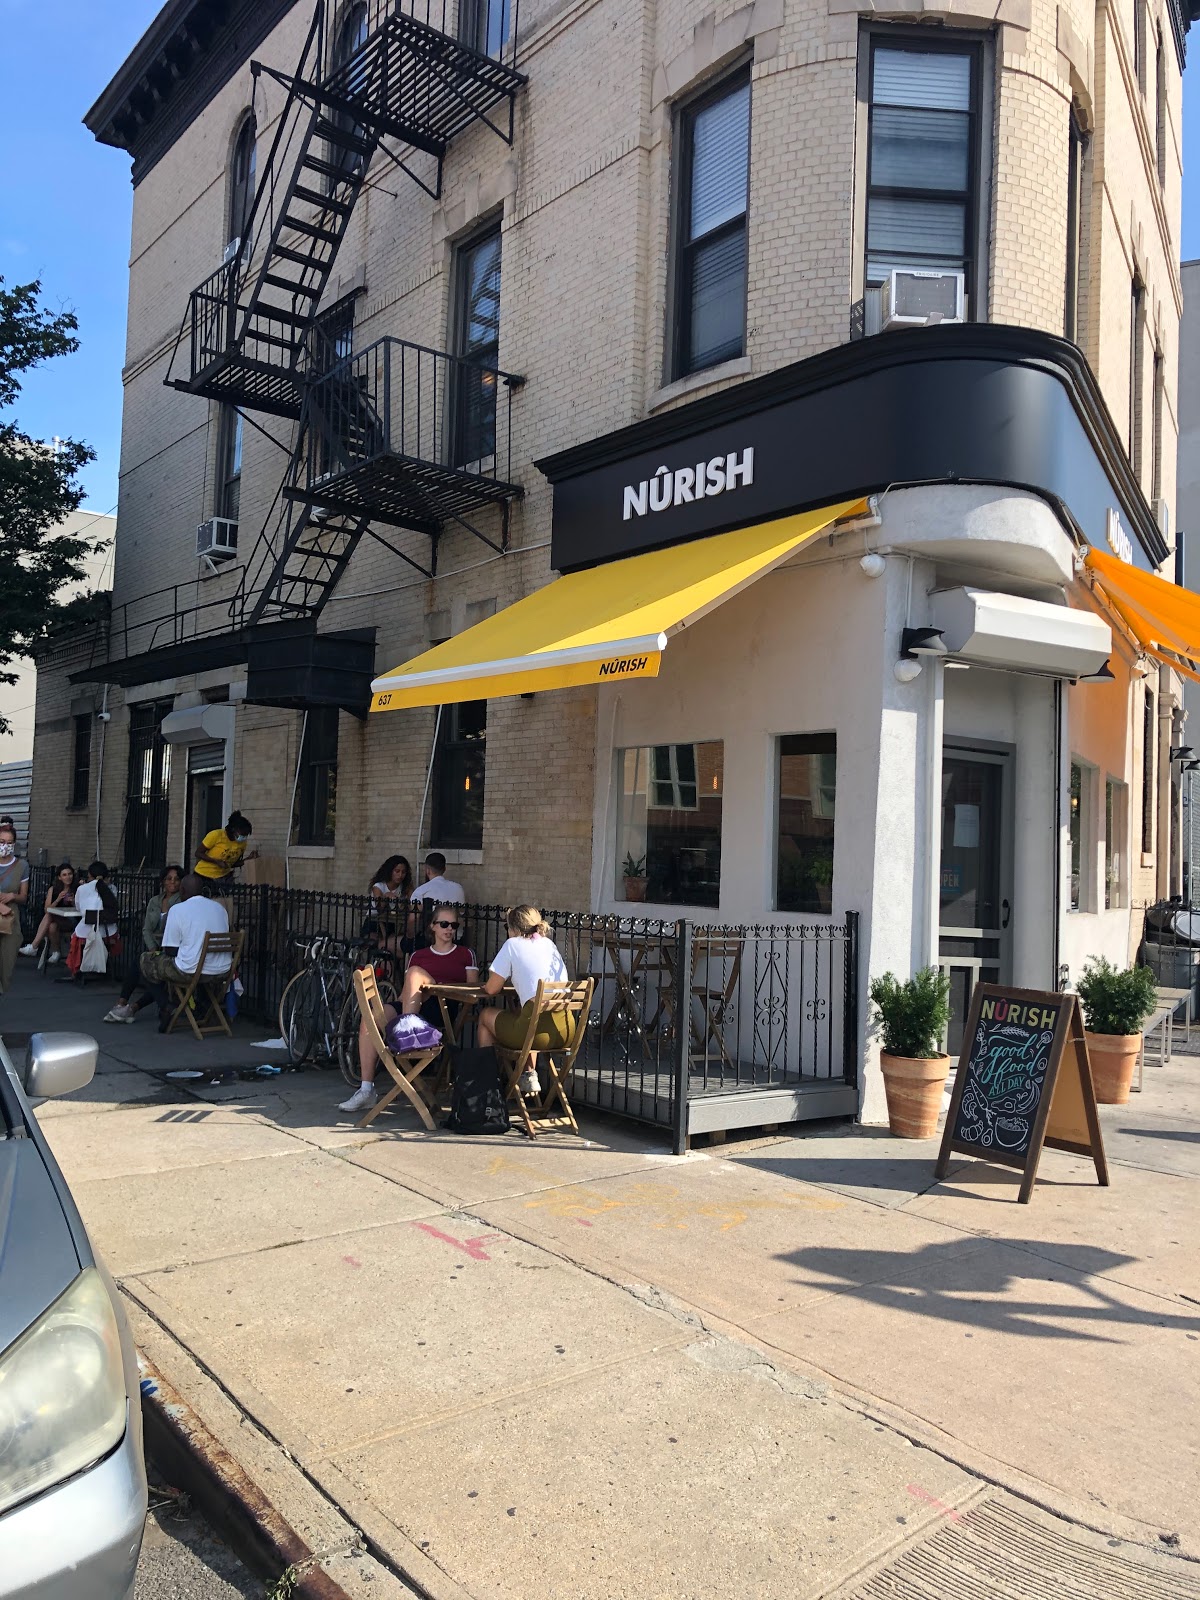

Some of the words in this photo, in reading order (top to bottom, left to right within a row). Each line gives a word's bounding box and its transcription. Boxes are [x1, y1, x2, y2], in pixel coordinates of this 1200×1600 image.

[623, 446, 754, 520] NÛRISH
[599, 657, 648, 675] NÛRISH
[378, 694, 392, 705] 637
[981, 998, 1056, 1029] NÛRISH
[978, 1034, 1038, 1084] good
[989, 1046, 1046, 1089] food
[988, 1082, 1006, 1097] ALL
[1008, 1076, 1026, 1090] DAY
